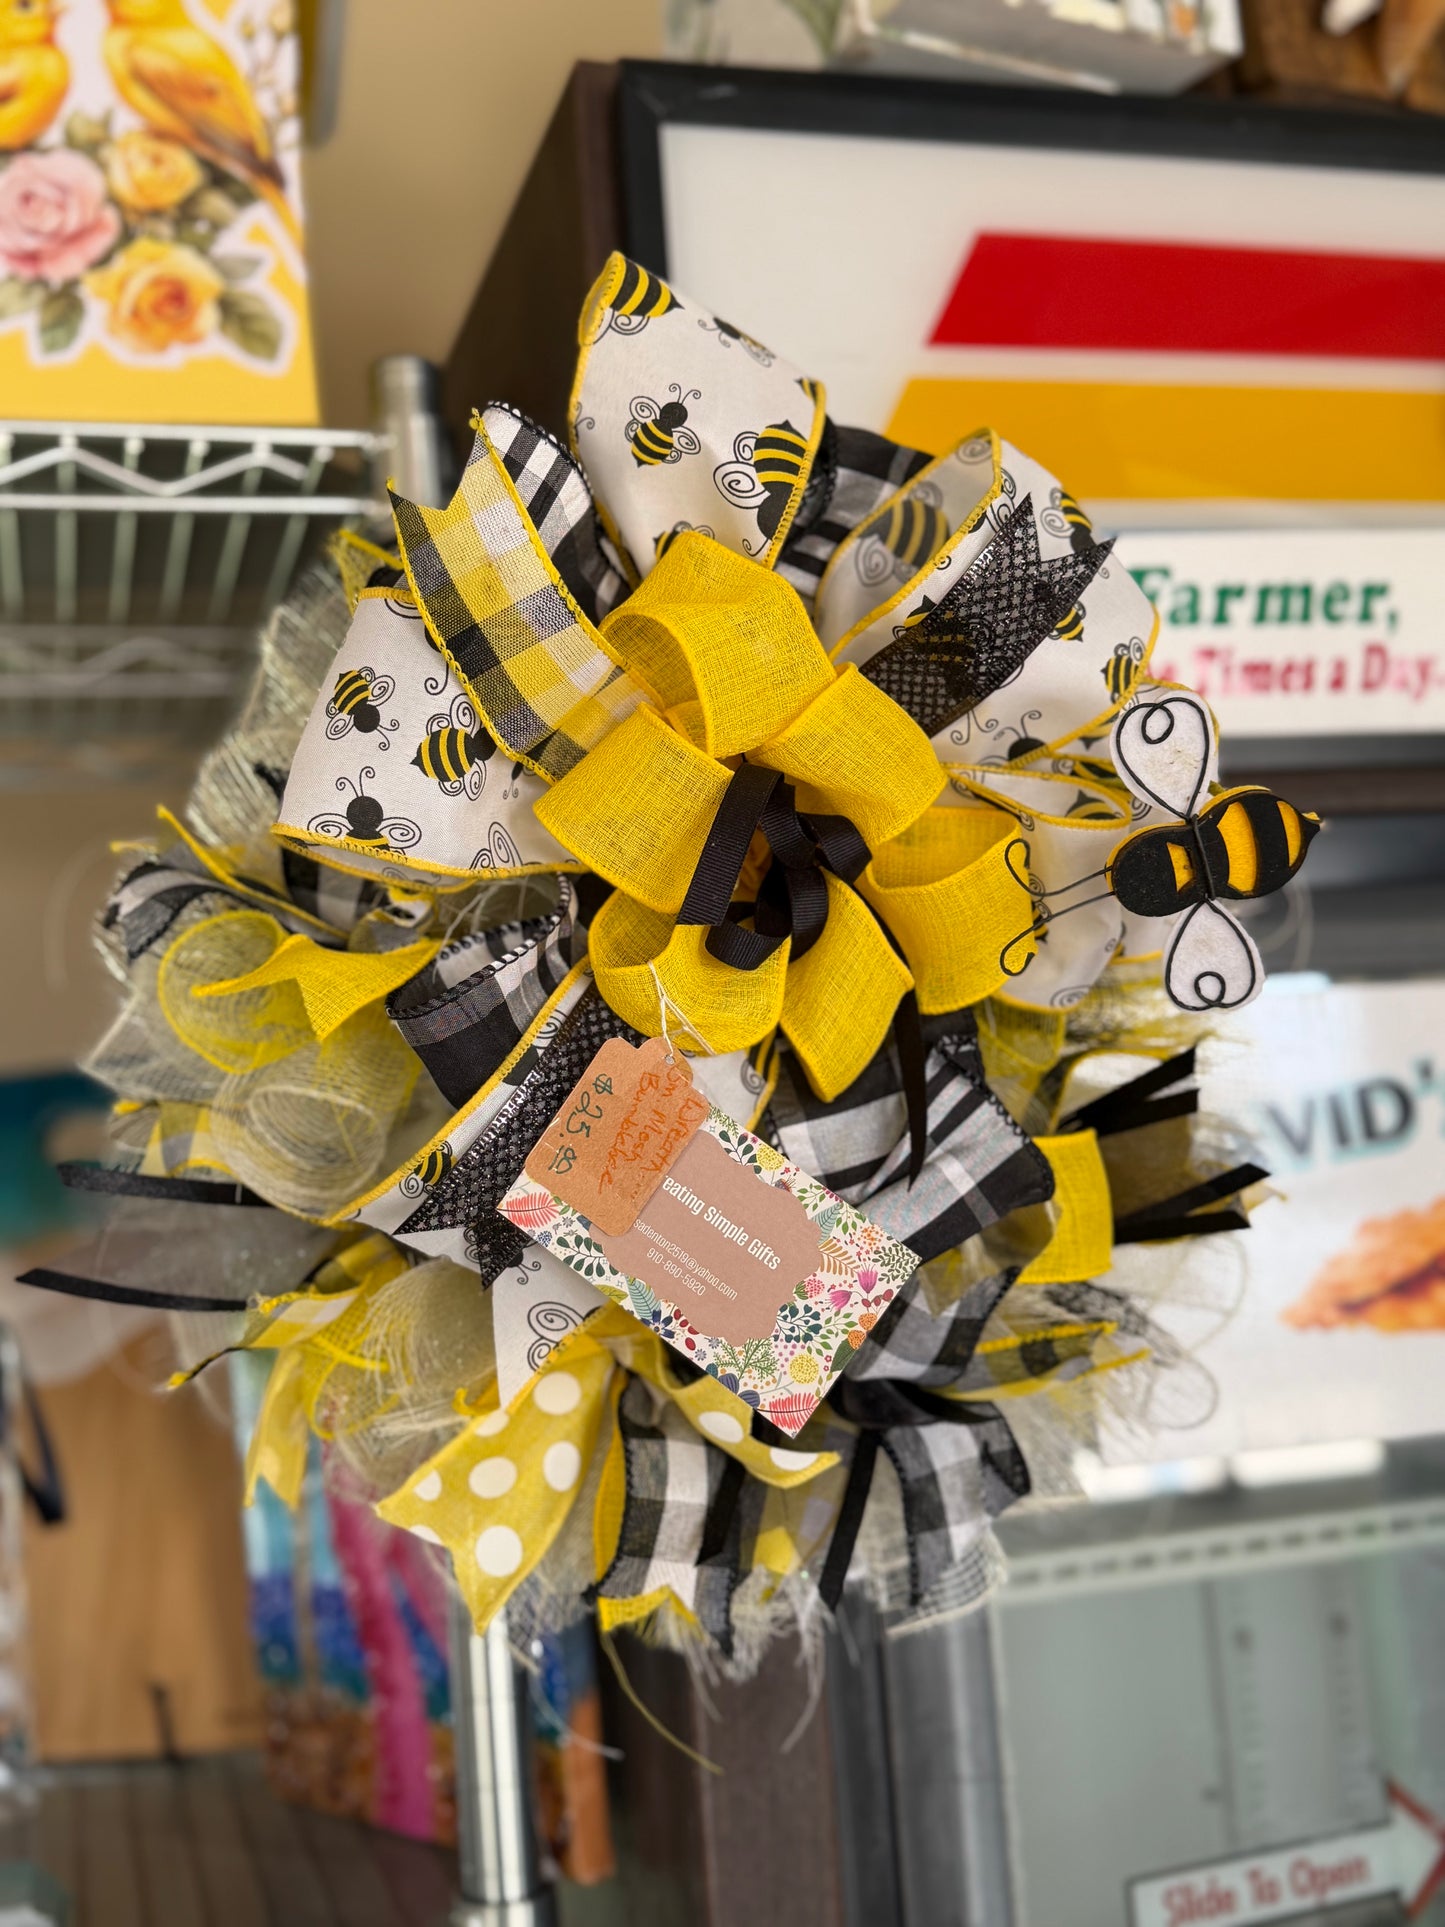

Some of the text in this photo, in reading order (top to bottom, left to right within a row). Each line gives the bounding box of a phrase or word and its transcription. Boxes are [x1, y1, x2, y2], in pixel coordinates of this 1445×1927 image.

[597, 1072, 658, 1195] Bumblebee
[624, 1108, 666, 1162] Mesh
[1263, 1058, 1434, 1157] VID'
[661, 1174, 781, 1270] eating Simple Gifts
[646, 1247, 706, 1296] 910-890-5920
[1162, 1855, 1371, 1927] Slide To Open
